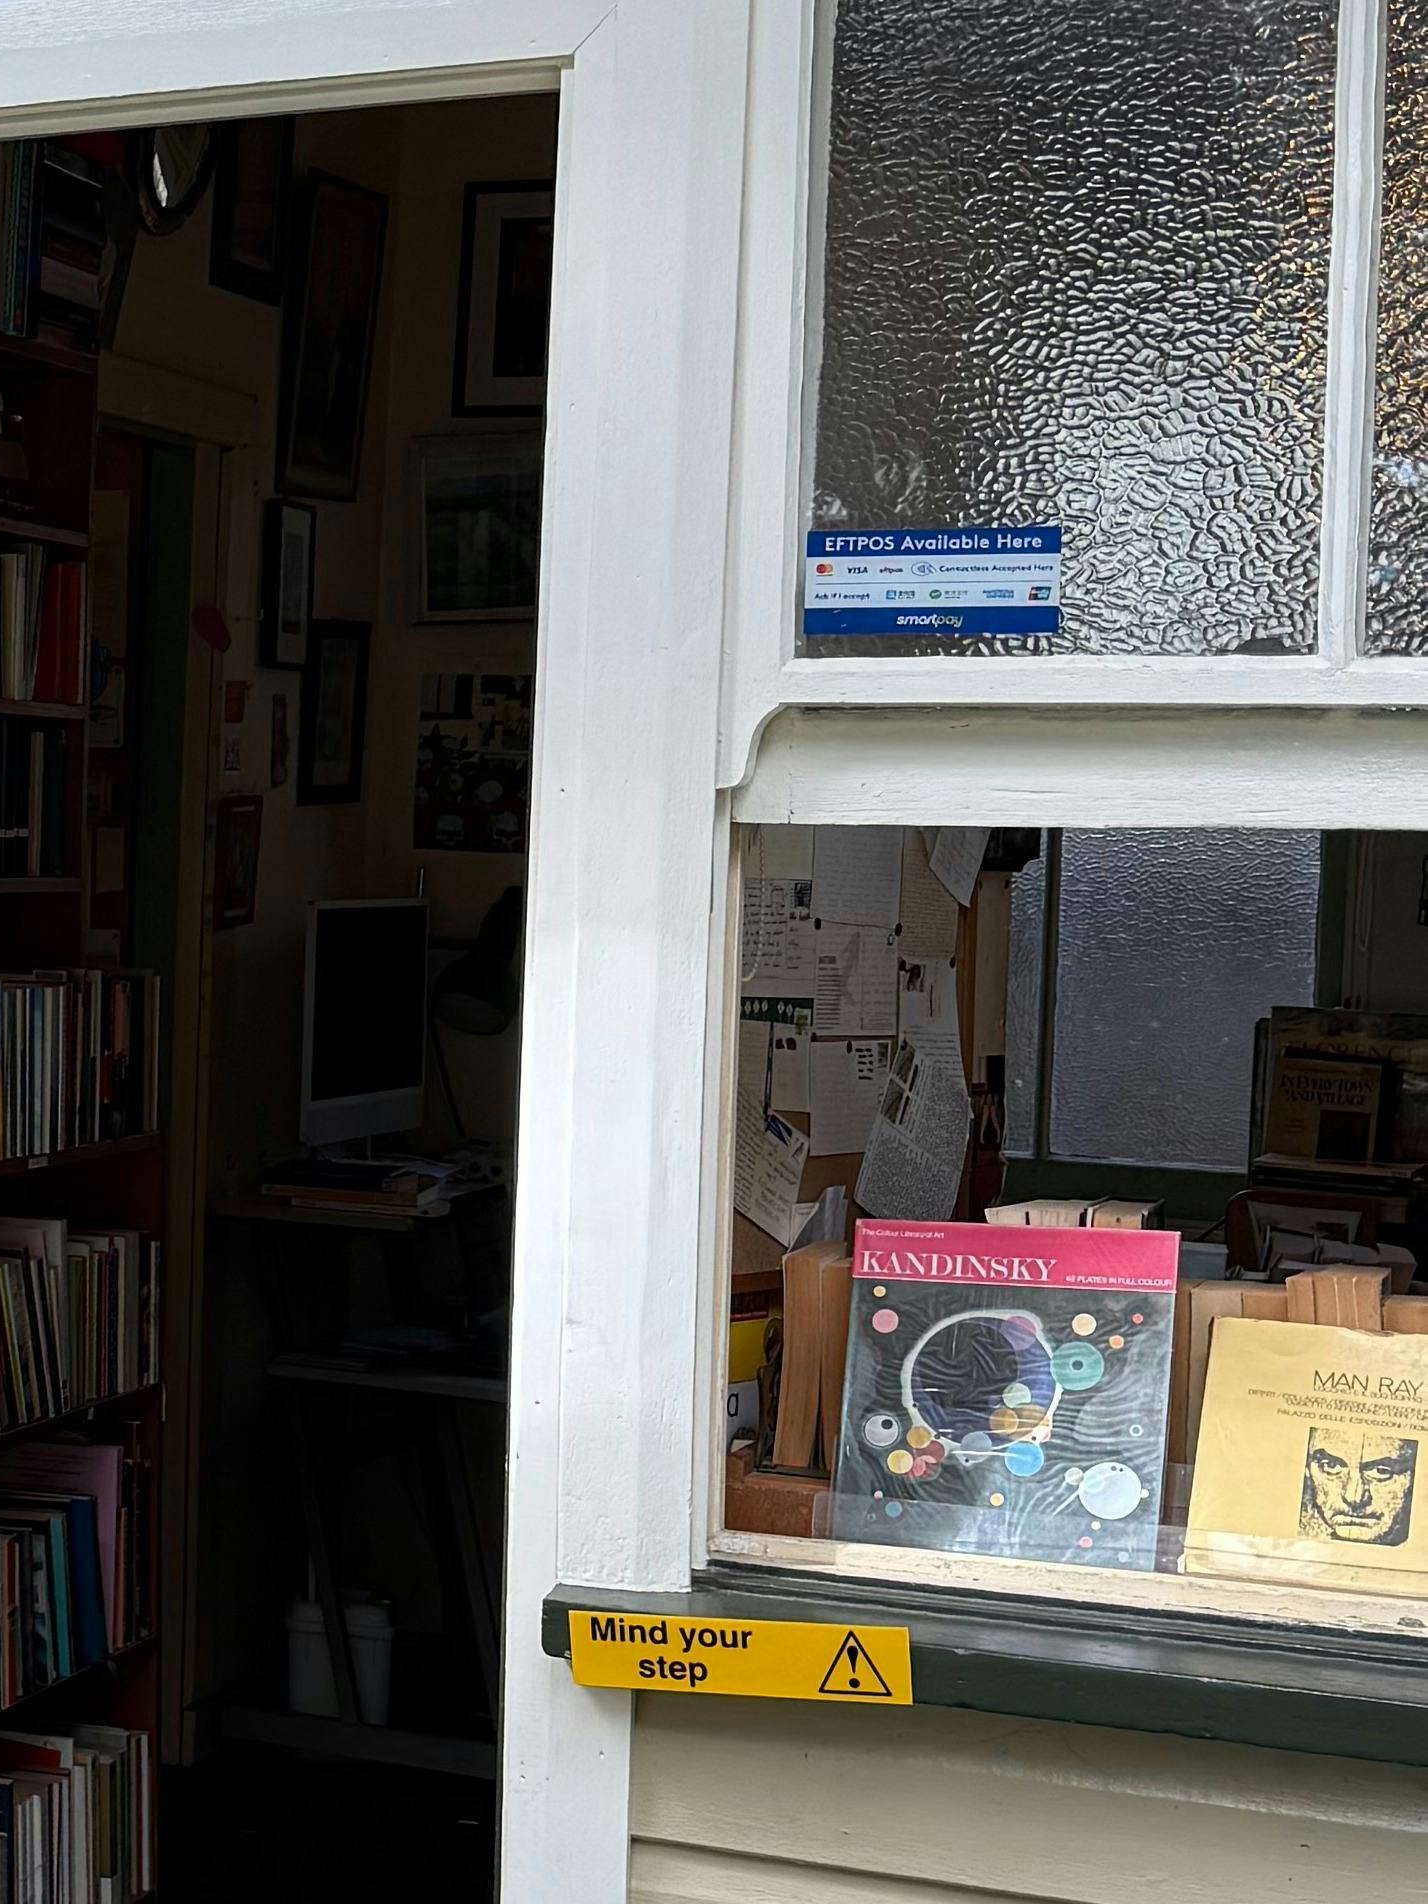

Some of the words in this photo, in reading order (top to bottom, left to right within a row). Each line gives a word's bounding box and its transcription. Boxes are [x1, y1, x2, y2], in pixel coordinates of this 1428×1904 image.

[824, 536, 895, 552] EFTPOS
[900, 533, 990, 551] Available
[996, 533, 1043, 549] Here
[846, 566, 869, 575] VISA
[895, 612, 964, 628] smartpay
[862, 1228, 875, 1237] The
[860, 1249, 1058, 1282] KANDINSKY
[1313, 1369, 1369, 1393] MAN
[1378, 1376, 1424, 1397] RAY
[589, 1616, 669, 1646] Mind
[679, 1629, 753, 1655] your
[638, 1655, 709, 1688] step
